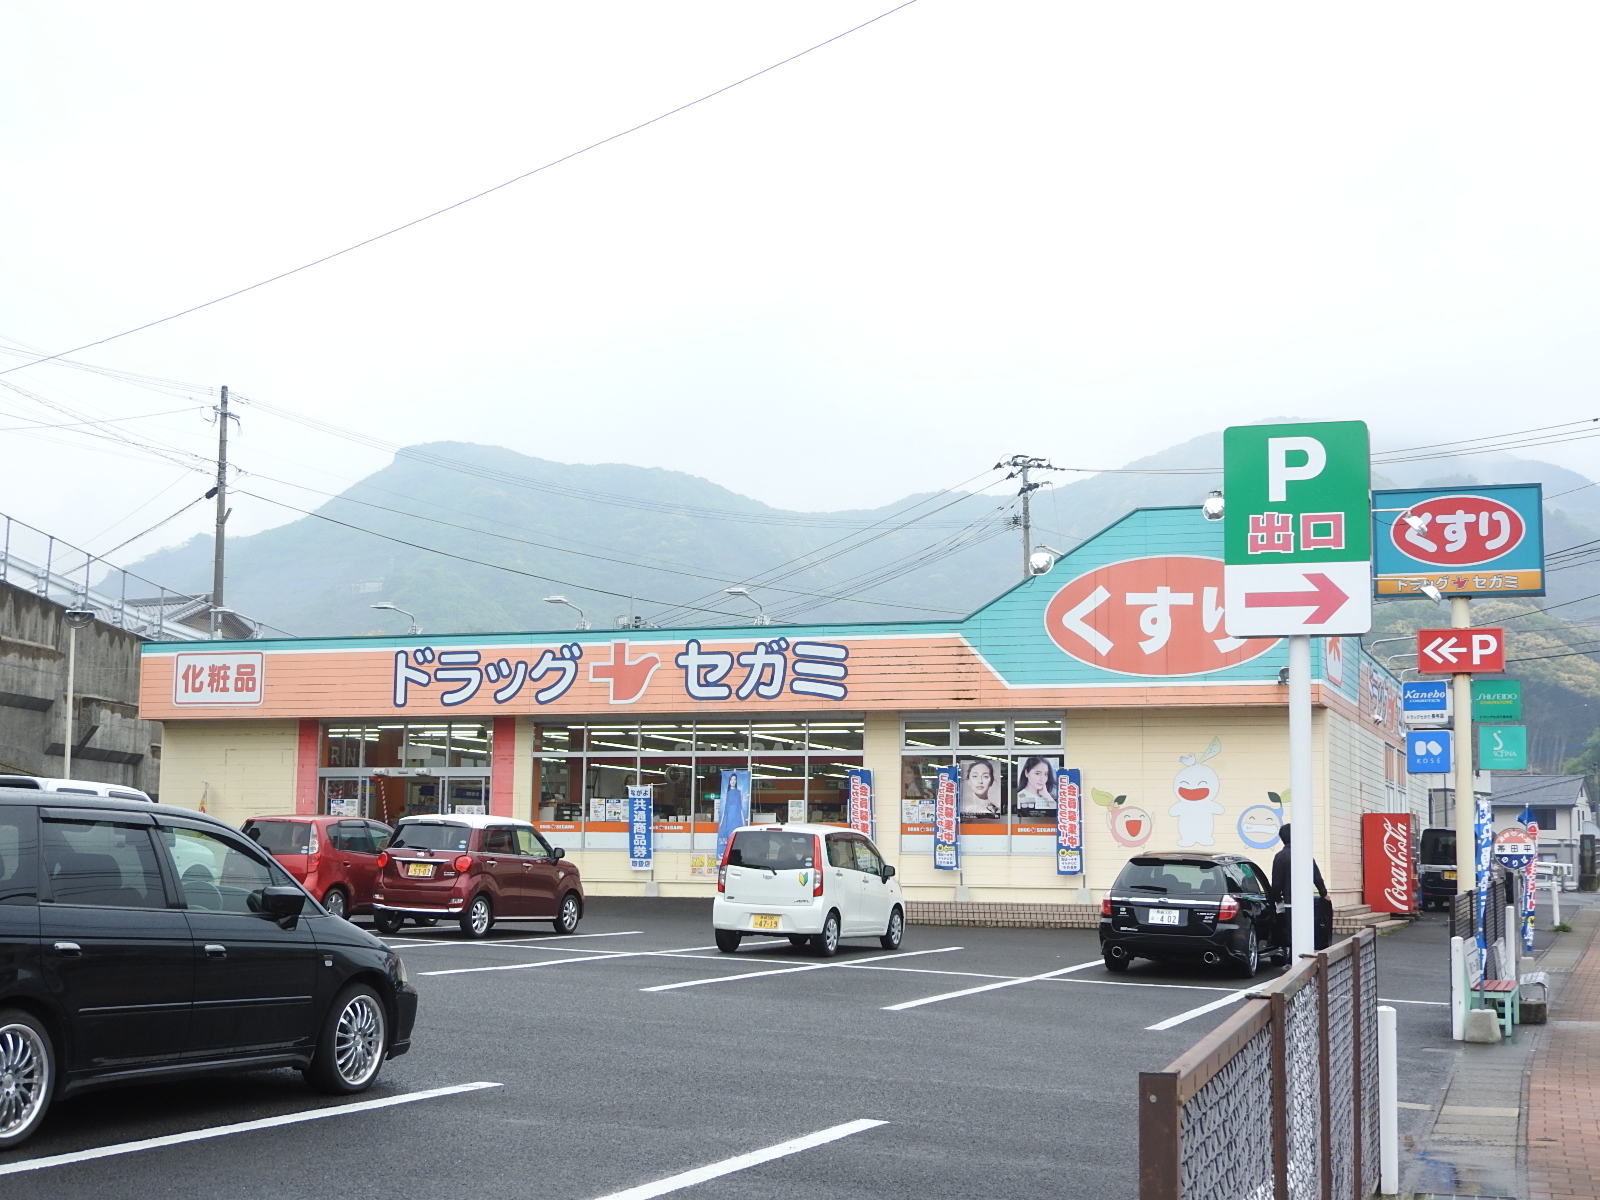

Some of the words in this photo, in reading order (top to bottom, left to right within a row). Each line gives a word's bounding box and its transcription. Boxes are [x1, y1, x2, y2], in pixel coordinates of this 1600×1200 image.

[1268, 436, 1327, 502] P
[1248, 512, 1345, 555] 出口
[1404, 509, 1511, 553] くすり
[1473, 574, 1519, 590] セガミ
[1472, 634, 1498, 665] P
[181, 663, 257, 694] 化粧品
[393, 641, 583, 708] ドラッグ
[675, 637, 849, 701] セガミ
[1404, 689, 1446, 699] Kanebo
[1475, 693, 1518, 701] SHISEIDO
[633, 798, 647, 858] 共通商品券
[1383, 816, 1409, 911] Coca-Cola
